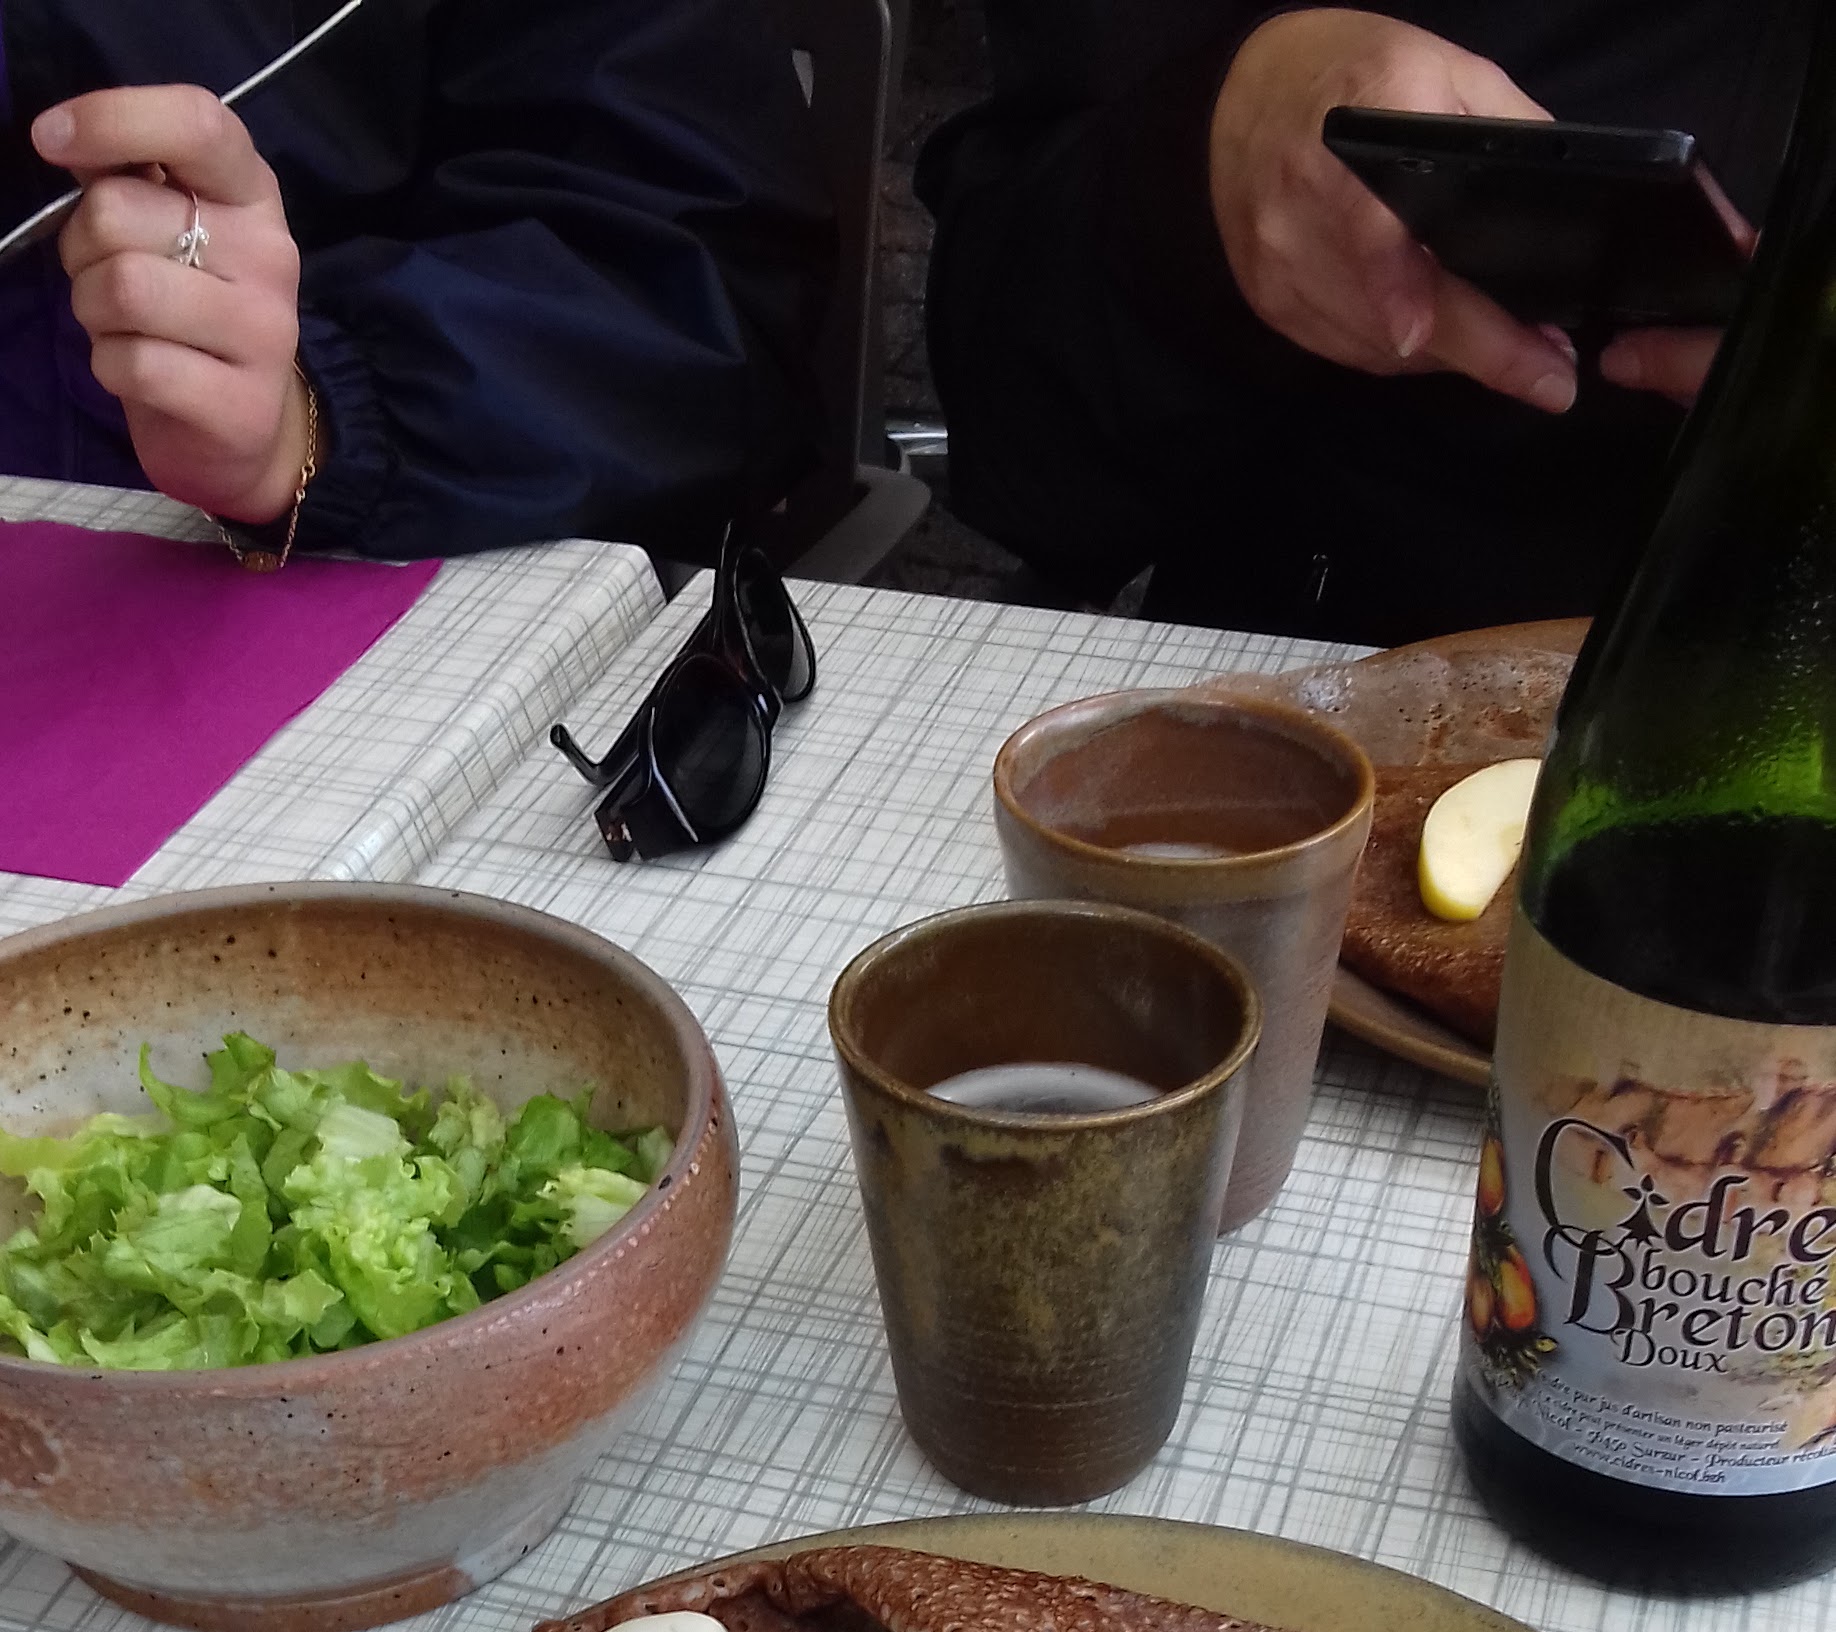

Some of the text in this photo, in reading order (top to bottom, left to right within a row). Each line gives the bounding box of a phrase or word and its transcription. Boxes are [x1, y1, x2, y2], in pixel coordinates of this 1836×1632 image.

[1535, 1118, 1836, 1262] Cidre
[1543, 1224, 1836, 1352] Breton
[1641, 1248, 1829, 1307] bouché
[1612, 1329, 1728, 1373] Doux
[1573, 1389, 1597, 1403] pur
[1686, 1420, 1711, 1432] non
[1632, 1441, 1686, 1461] Surzur
[1705, 1453, 1790, 1469] Producteur
